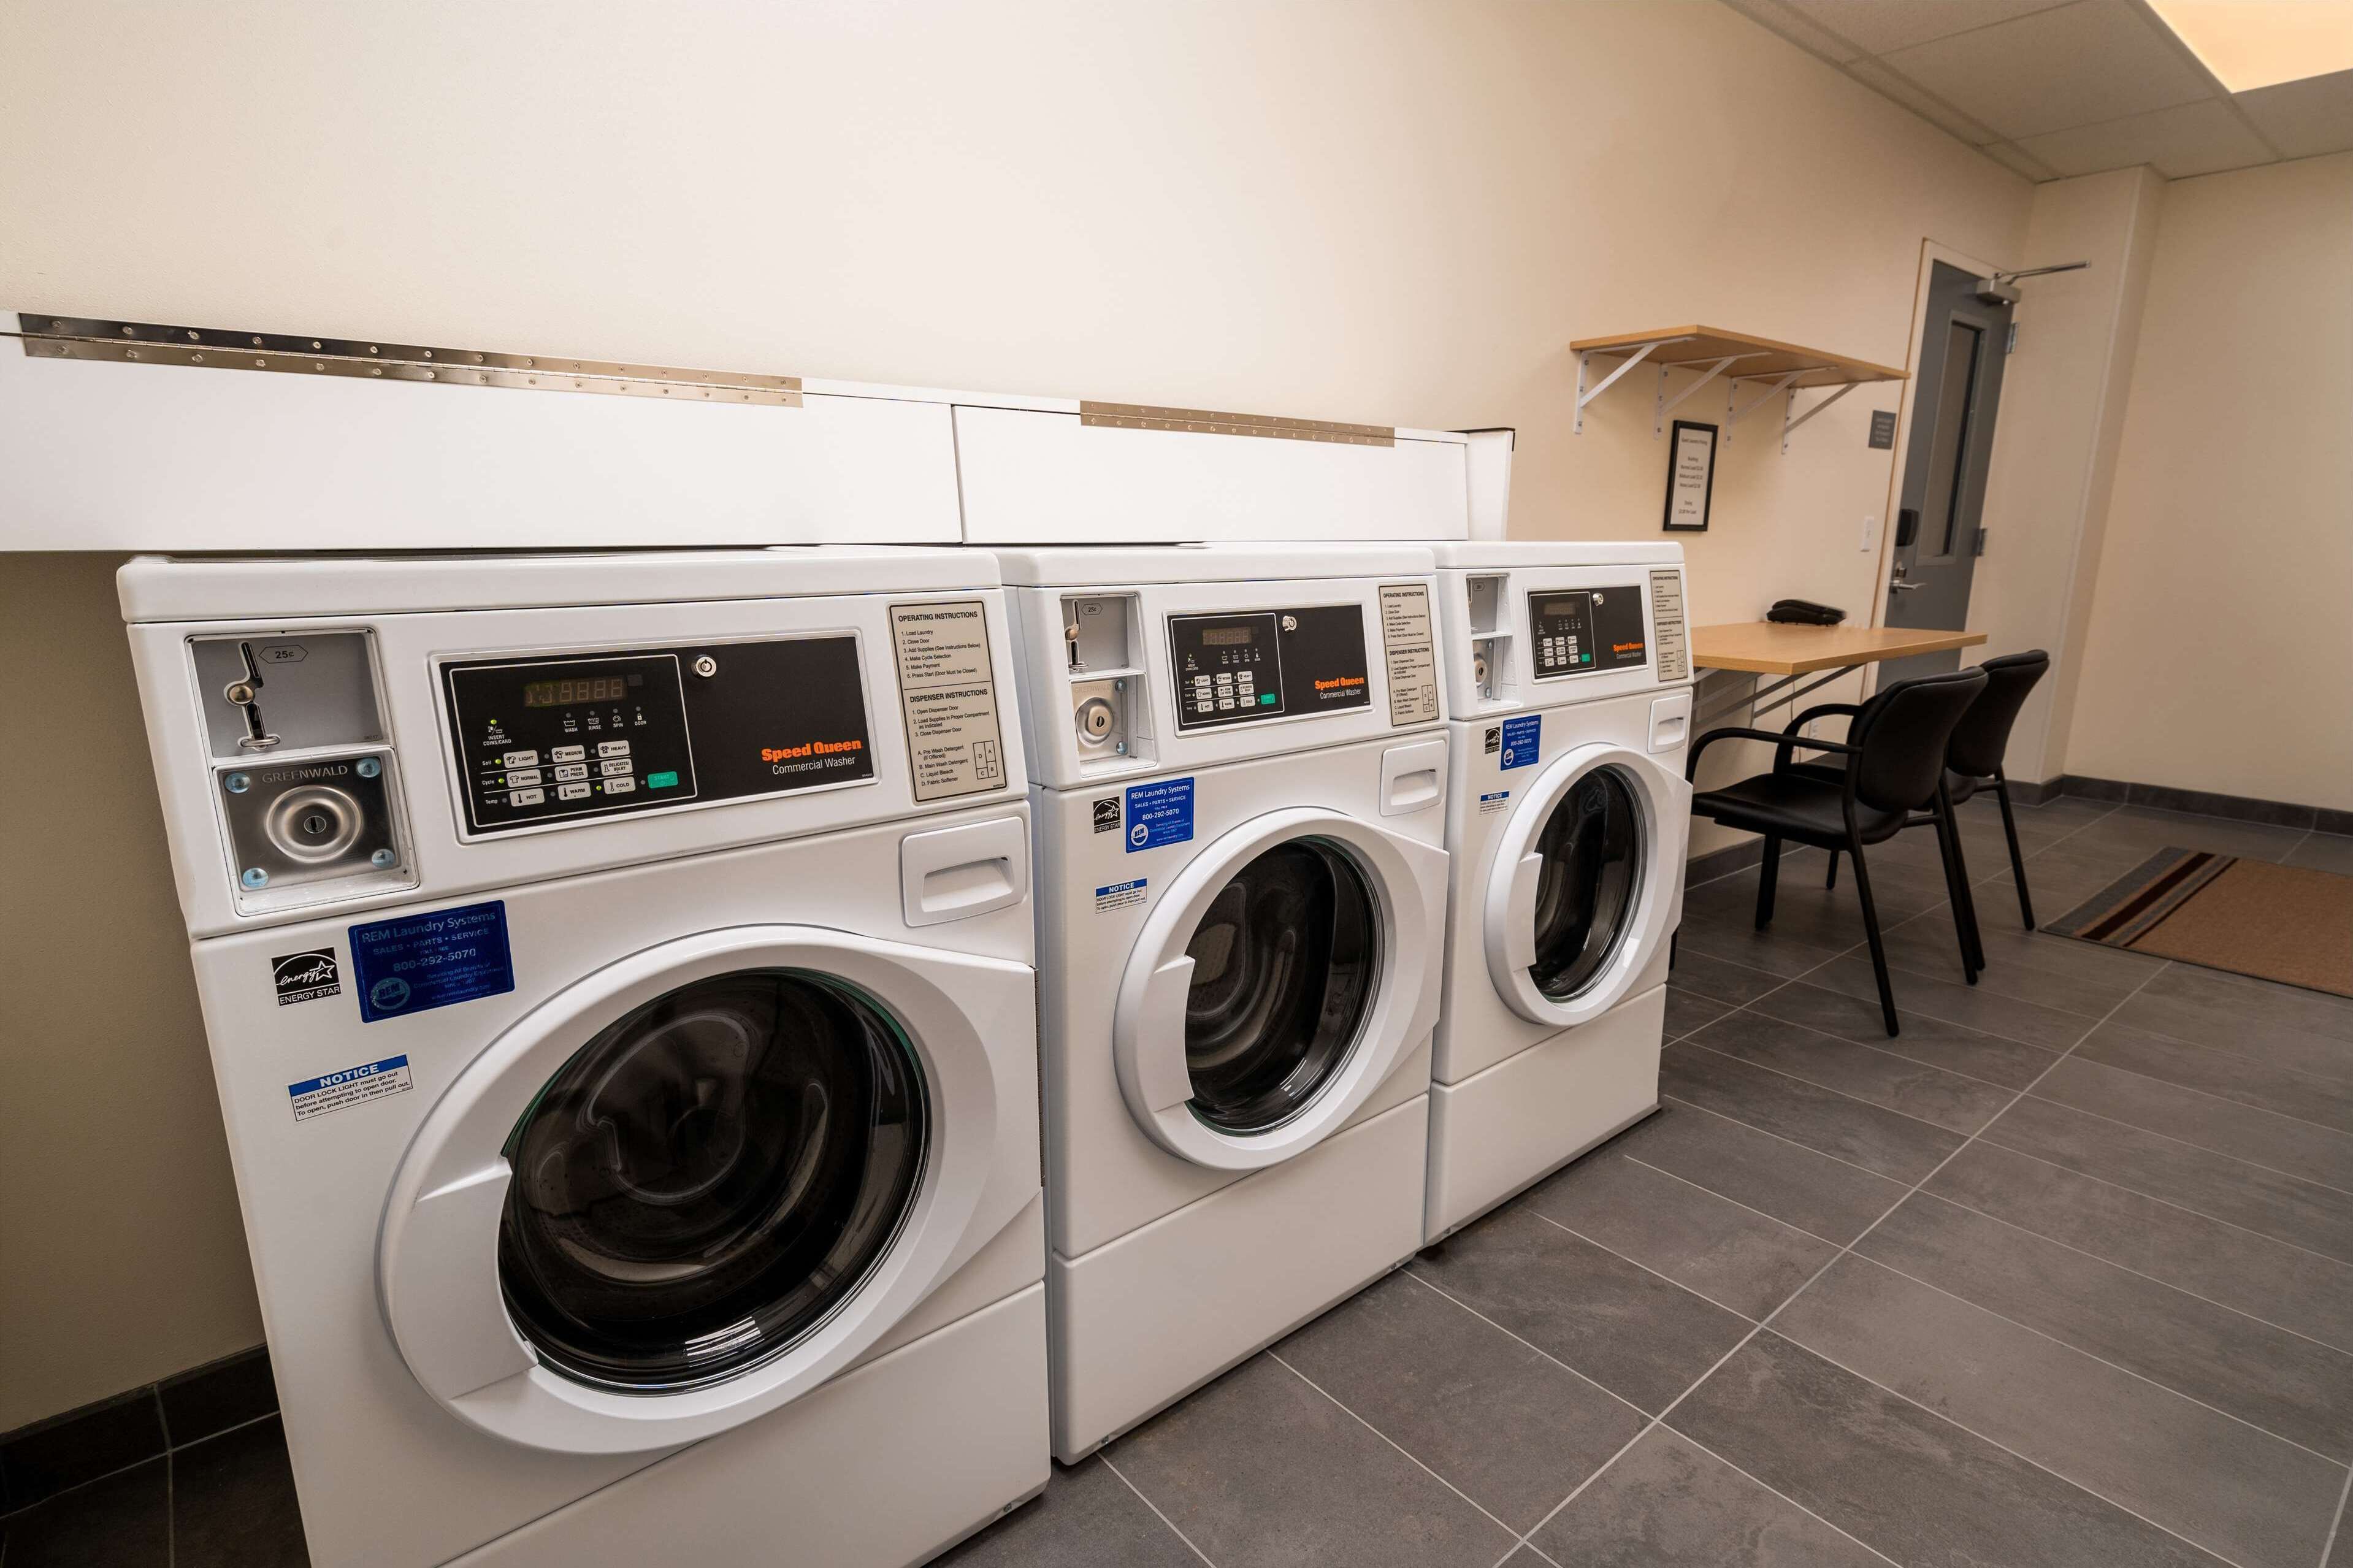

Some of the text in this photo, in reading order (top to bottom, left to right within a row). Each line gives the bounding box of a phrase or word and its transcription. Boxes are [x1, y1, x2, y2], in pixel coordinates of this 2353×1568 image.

[935, 611, 978, 619] INSTRUCTIONS
[274, 650, 294, 659] 25¢
[1315, 677, 1364, 690] Speed Queen
[910, 689, 987, 703] DISPENSER INSTRUCTIONS
[1320, 690, 1345, 699] Commercial
[762, 740, 862, 762] Speed Queen
[773, 756, 855, 774] Commercial Washer
[262, 765, 348, 784] GREENWALD
[1131, 785, 1190, 800] REM Laundry Systems
[1142, 808, 1179, 820] 800-292-5070
[1109, 882, 1134, 893] NOTICE
[362, 912, 495, 943] REM Laundry Systems
[373, 928, 489, 955] SALES PARTS SERVICE
[393, 948, 476, 971] 800-292-5070
[280, 986, 340, 1004] ENERGY STAR
[319, 1064, 379, 1087] NOTICE
[294, 1094, 315, 1104] DOOR
[317, 1088, 337, 1097] LOCK
[338, 1082, 359, 1092] LIGHT
[296, 1101, 317, 1110] before
[319, 1091, 354, 1104] attempting
[327, 1100, 344, 1109] push
